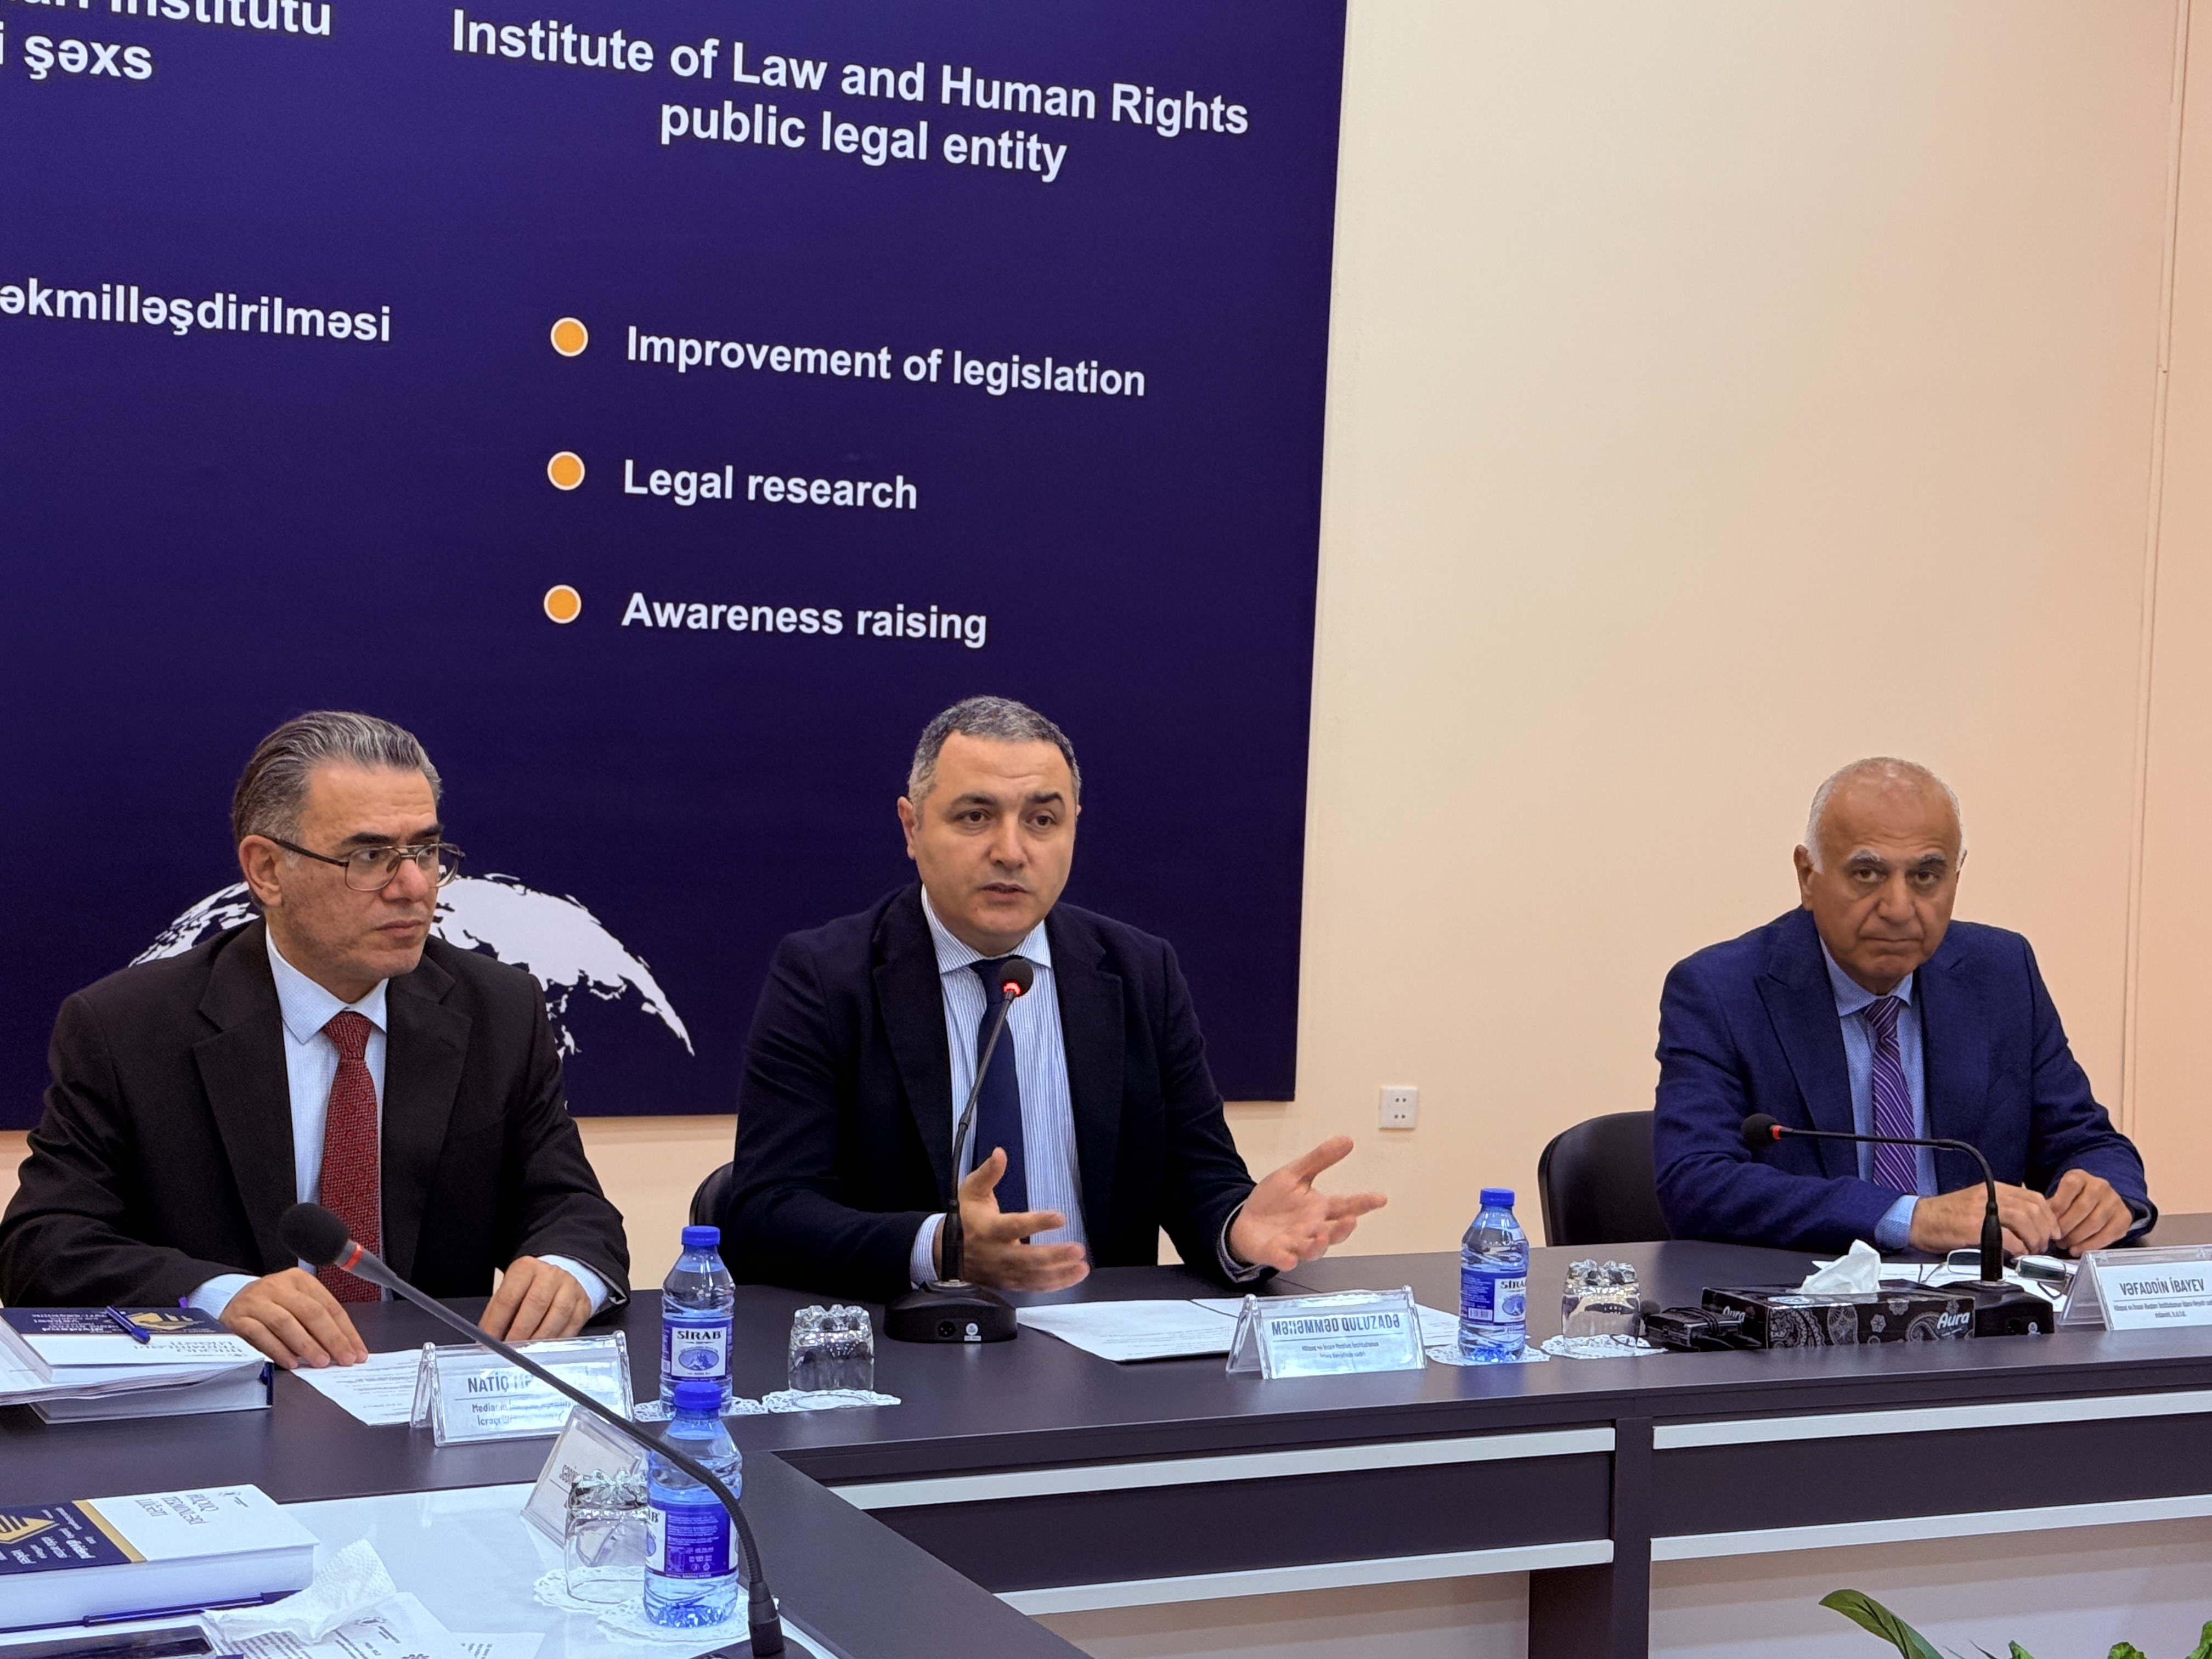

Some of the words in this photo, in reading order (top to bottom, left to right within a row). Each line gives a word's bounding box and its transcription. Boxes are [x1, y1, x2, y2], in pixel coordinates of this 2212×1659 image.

[24, 36, 153, 80] şəxs
[453, 9, 654, 72] Institute
[670, 38, 720, 78] of
[733, 41, 828, 91] Law
[841, 61, 925, 101] and
[941, 64, 1096, 119] Human
[1112, 83, 1248, 137] Rights
[661, 100, 805, 148] public
[822, 110, 928, 166] legal
[943, 130, 1068, 183] entity
[628, 325, 891, 379] Improvement
[903, 348, 943, 382] of
[953, 350, 1144, 396] legislation
[624, 459, 733, 506] Legal
[748, 475, 917, 509] research
[621, 592, 843, 635] Awareness
[857, 603, 986, 648] raising
[2169, 1277, 2205, 1293] İBAYEV
[1937, 1312, 1971, 1329] Aura
